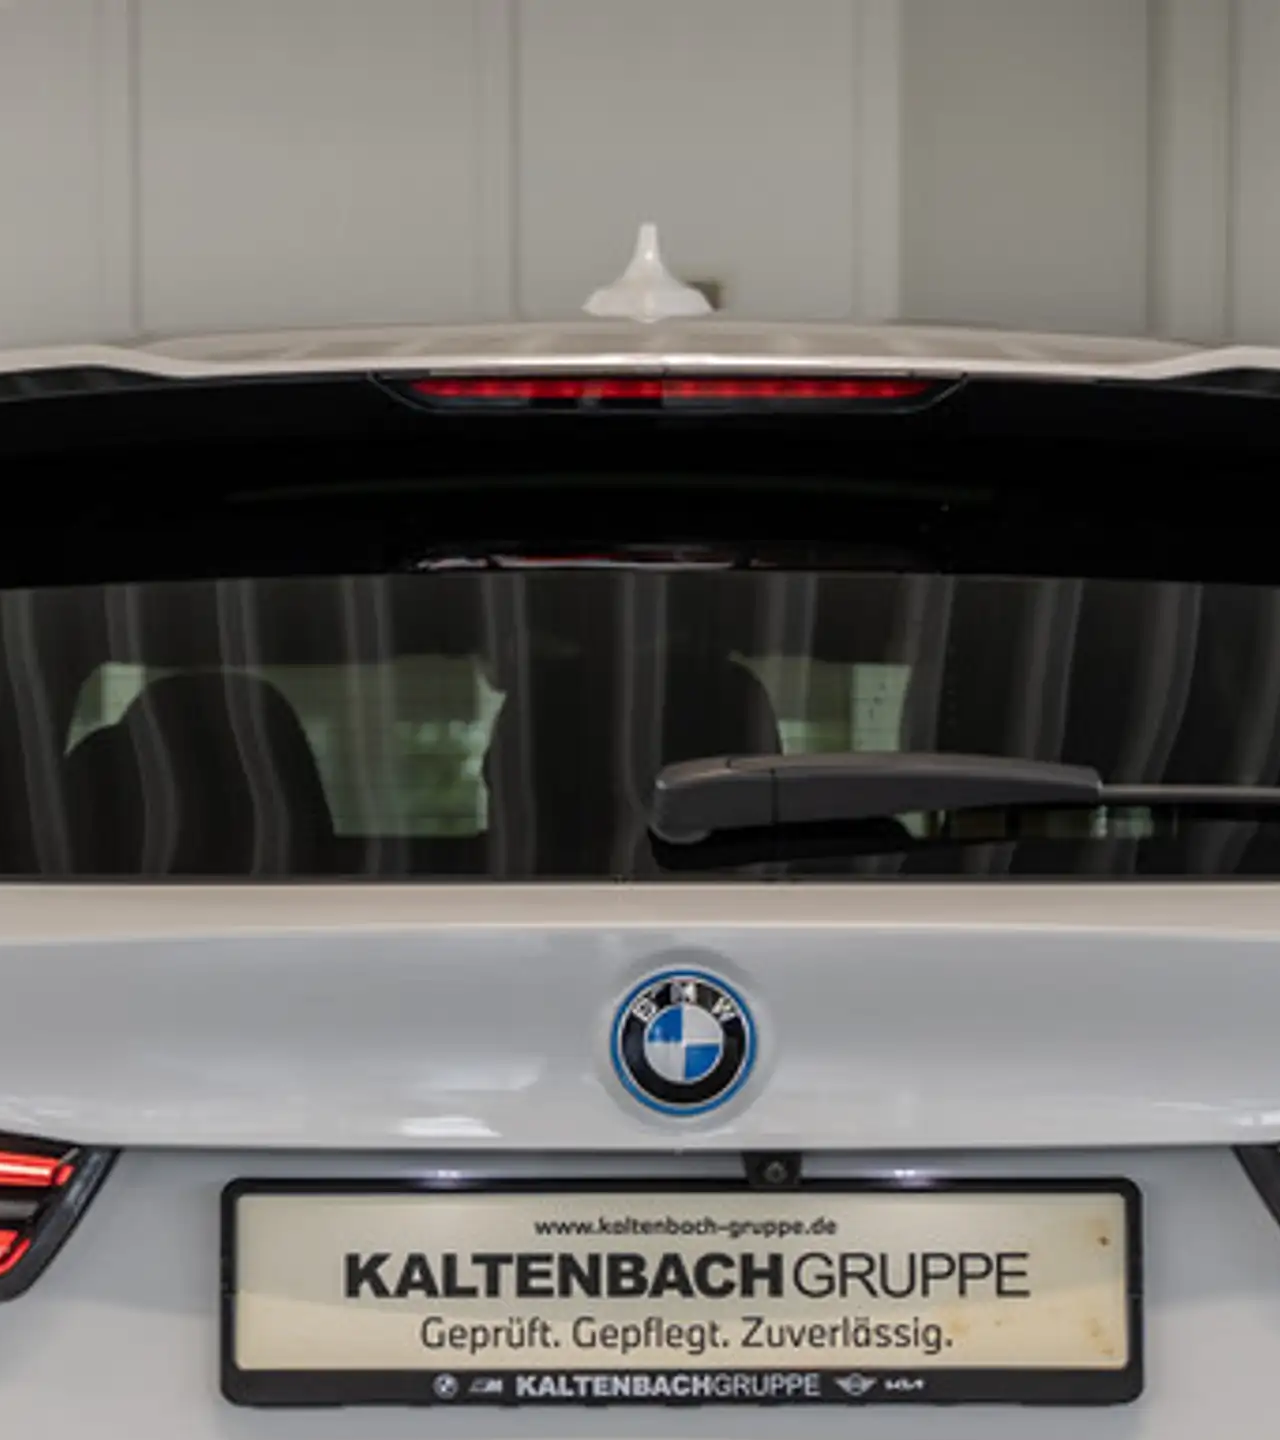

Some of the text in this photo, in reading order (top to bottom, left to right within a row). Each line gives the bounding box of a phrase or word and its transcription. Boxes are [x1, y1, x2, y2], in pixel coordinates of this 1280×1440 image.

[631, 979, 739, 1021] BMW
[534, 1217, 837, 1238] www.kaltenbach-gruppe.de
[421, 1316, 953, 1355] Geprüft. Gepflegt. Zuverlässig.
